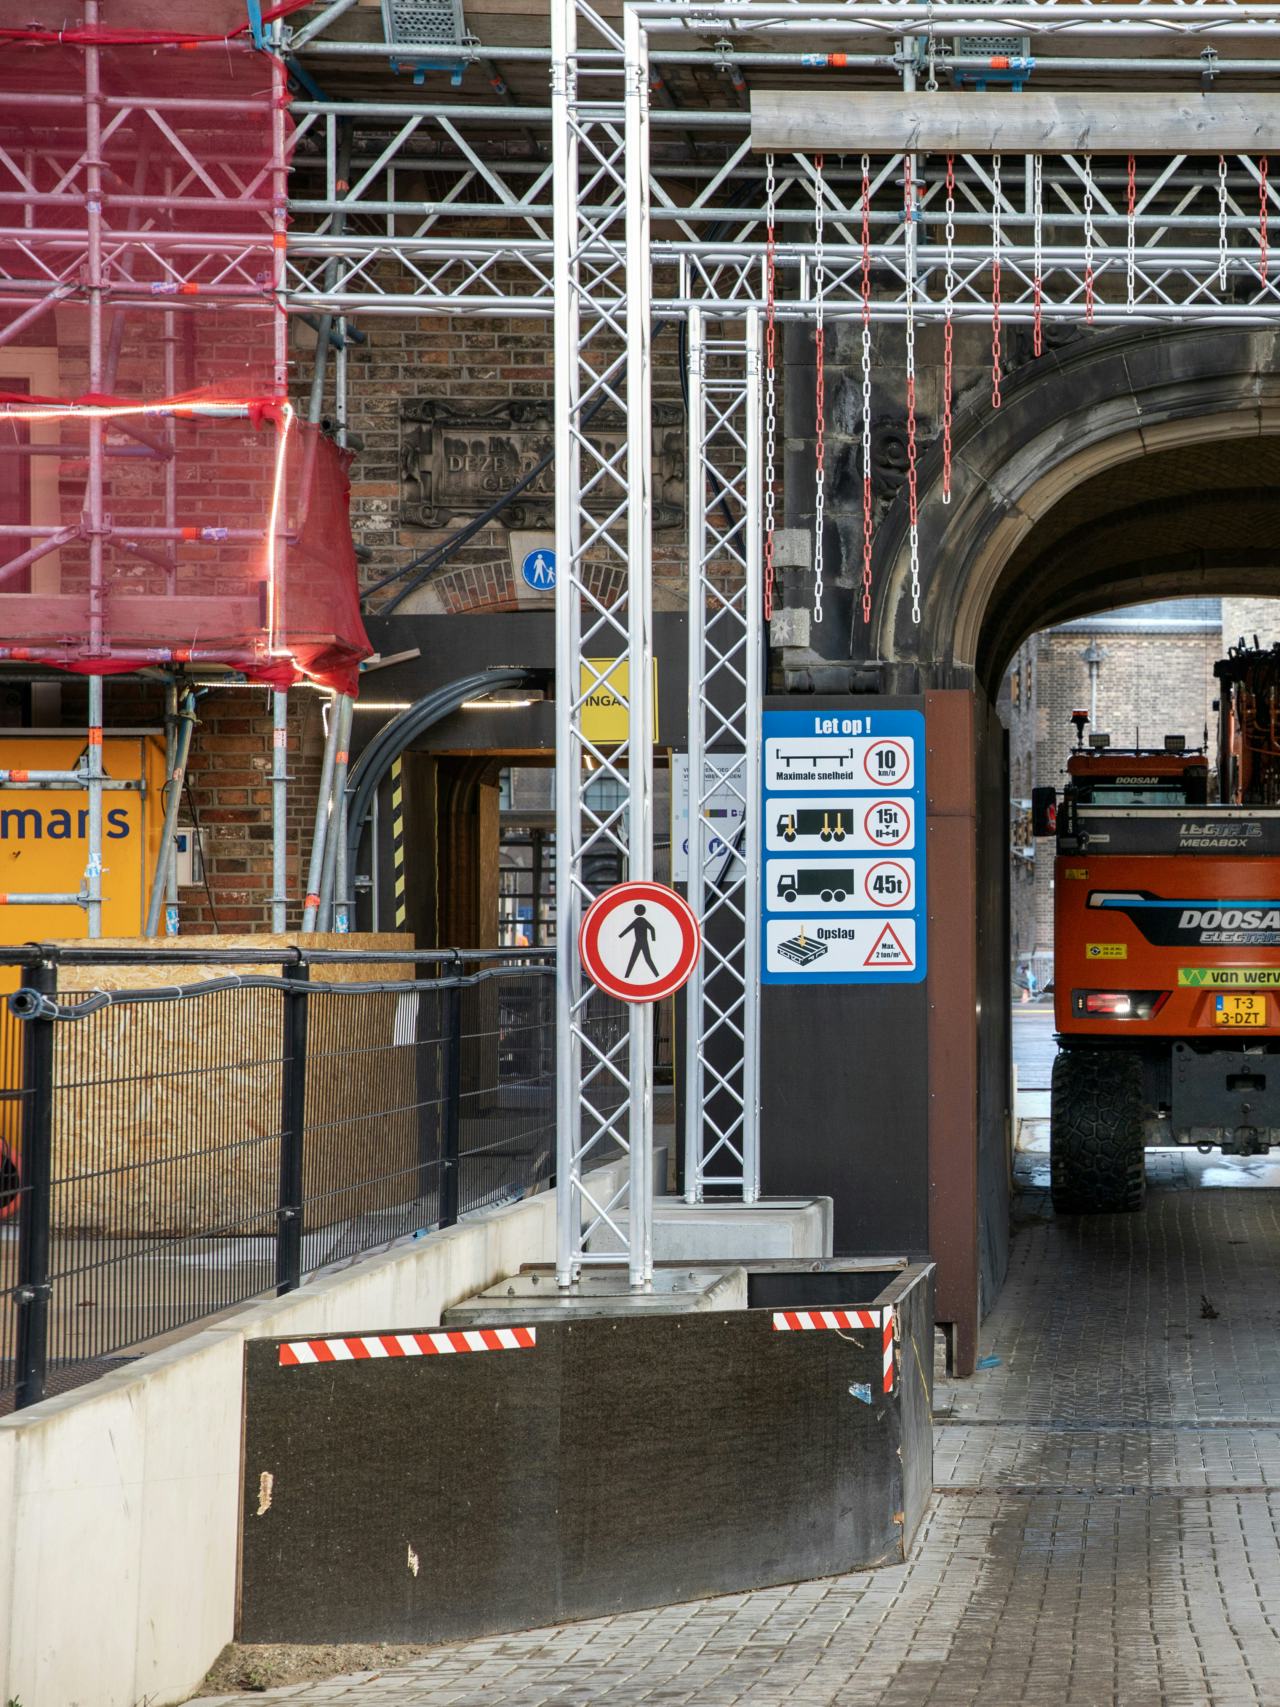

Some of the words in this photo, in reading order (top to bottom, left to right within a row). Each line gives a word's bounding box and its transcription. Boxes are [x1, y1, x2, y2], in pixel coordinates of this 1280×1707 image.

[815, 717, 839, 734] Let
[842, 720, 862, 736] op
[865, 717, 871, 733] !
[875, 750, 896, 769] 10
[776, 772, 816, 780] Maximale
[817, 771, 854, 780] snelheid
[877, 809, 898, 824] 15t
[1179, 839, 1248, 847] MEGABOX
[873, 875, 903, 894] 45t
[817, 928, 855, 940] Opslag
[1212, 972, 1238, 983] van
[1234, 998, 1254, 1009] T-3
[1222, 1013, 1260, 1024] 3-DZT
